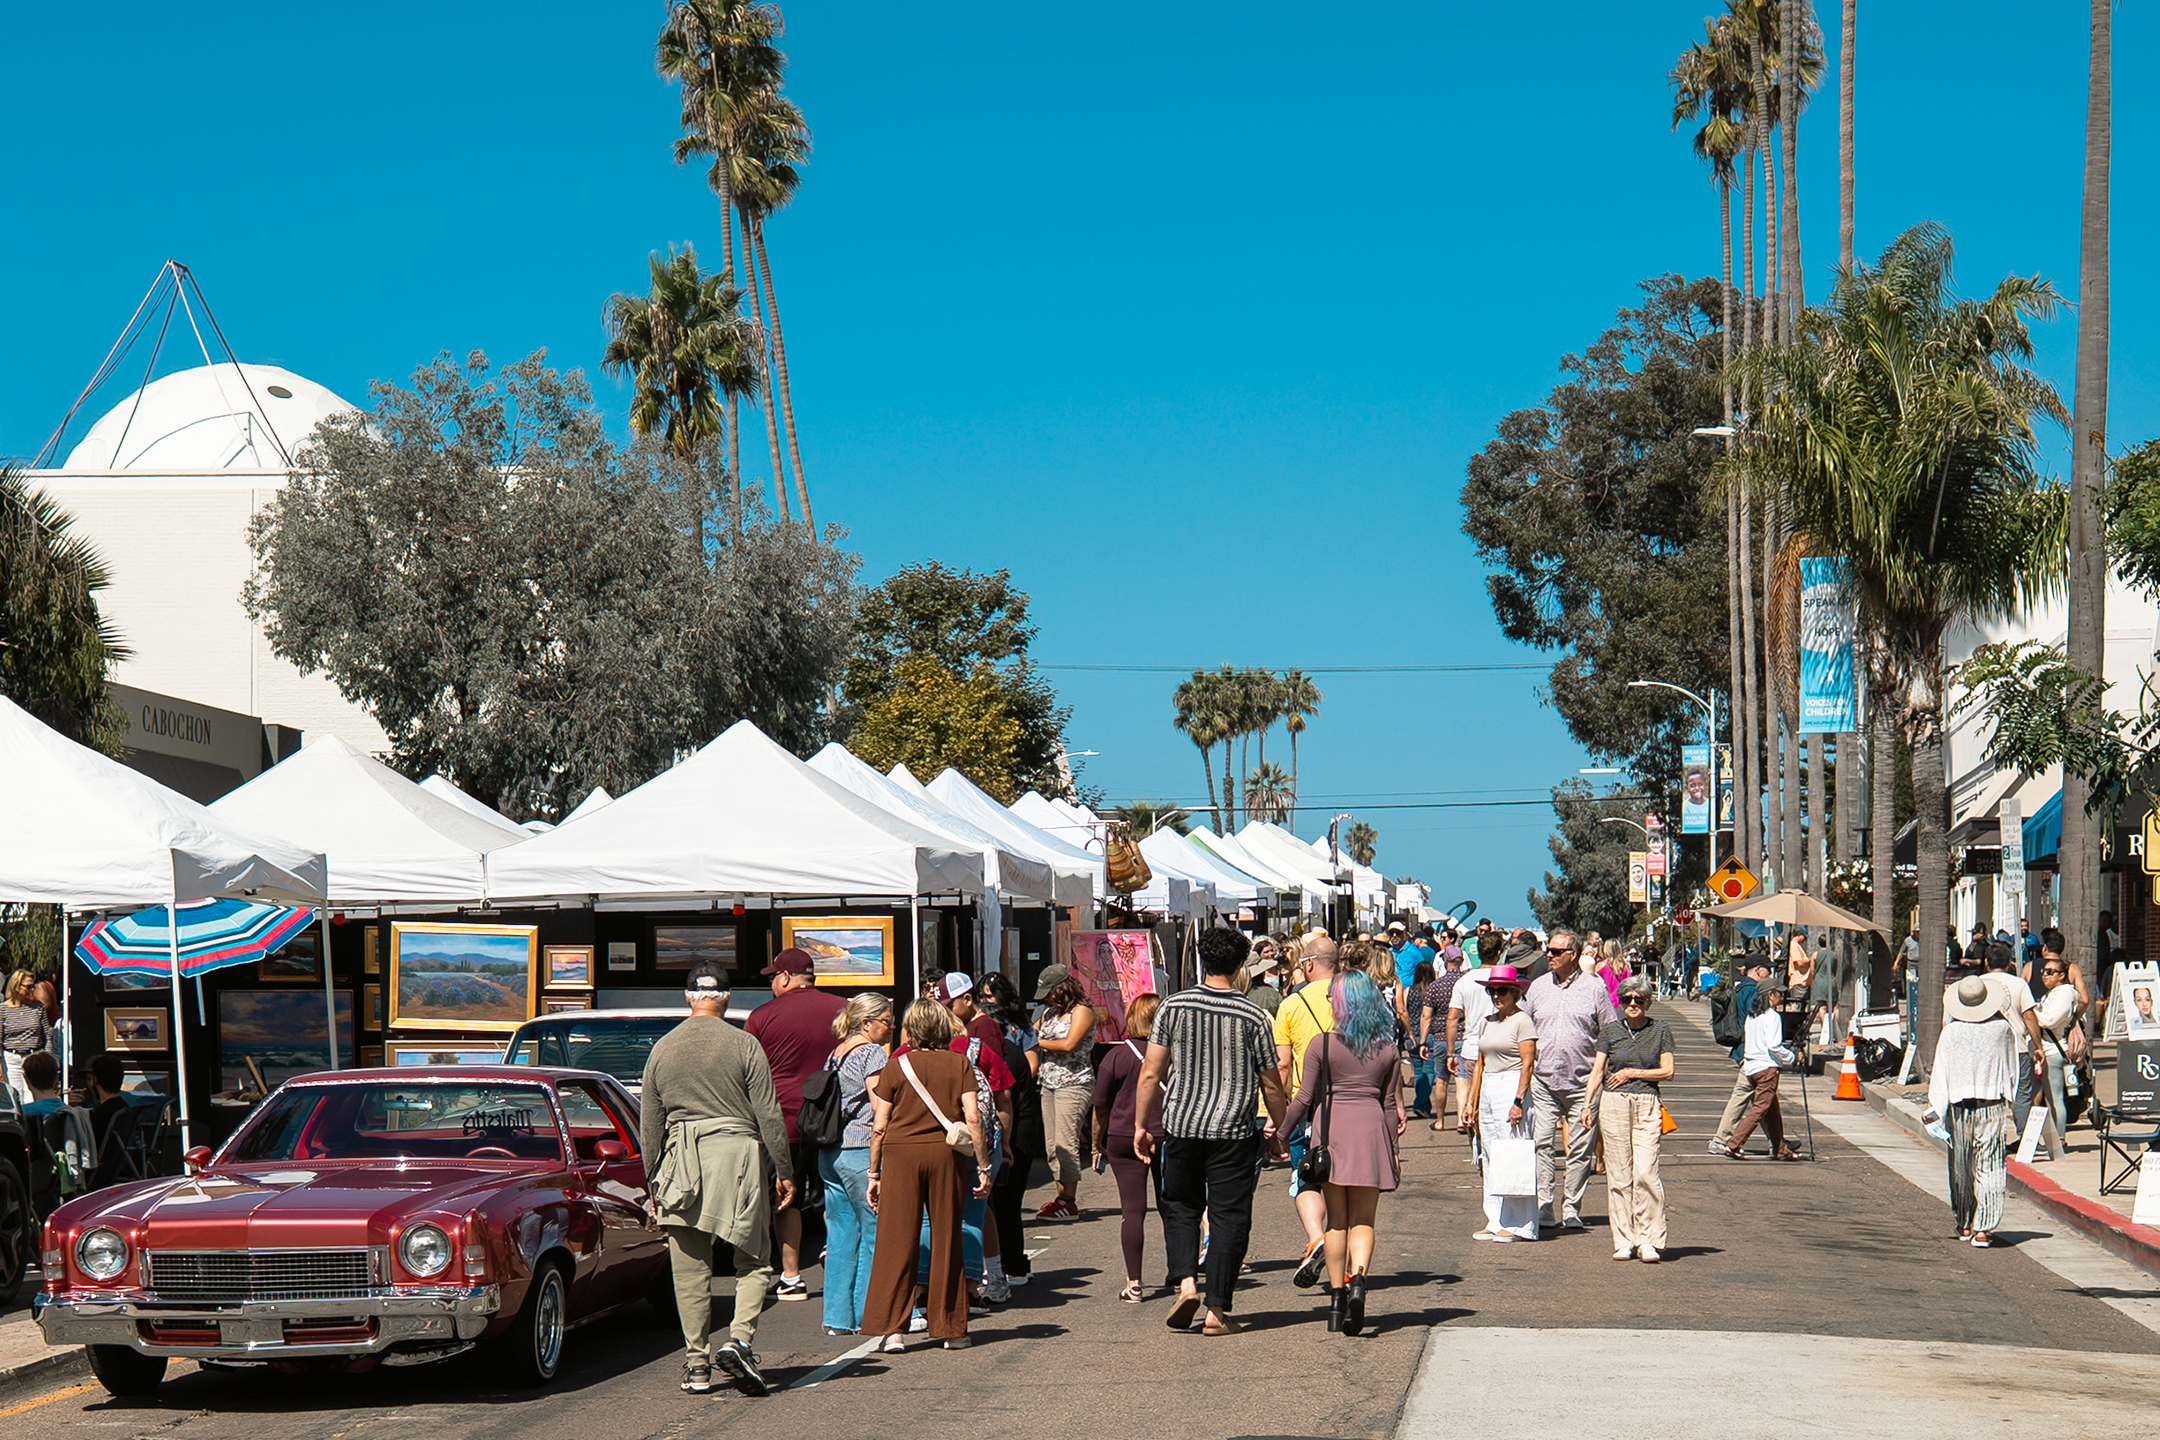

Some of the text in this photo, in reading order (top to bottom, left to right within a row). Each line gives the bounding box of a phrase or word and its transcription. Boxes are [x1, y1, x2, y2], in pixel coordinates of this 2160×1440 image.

[1804, 597, 1836, 608] SPEAK
[1814, 627, 1841, 637] HOPE
[1804, 698, 1832, 707] VOICES
[1804, 707, 1849, 717] CHILDREN
[142, 704, 211, 746] CABOCHON
[2003, 846, 2010, 859] 2
[1976, 857, 2002, 865] SHAD
[2004, 861, 2022, 871] PARKING
[1976, 864, 2002, 872] STOR
